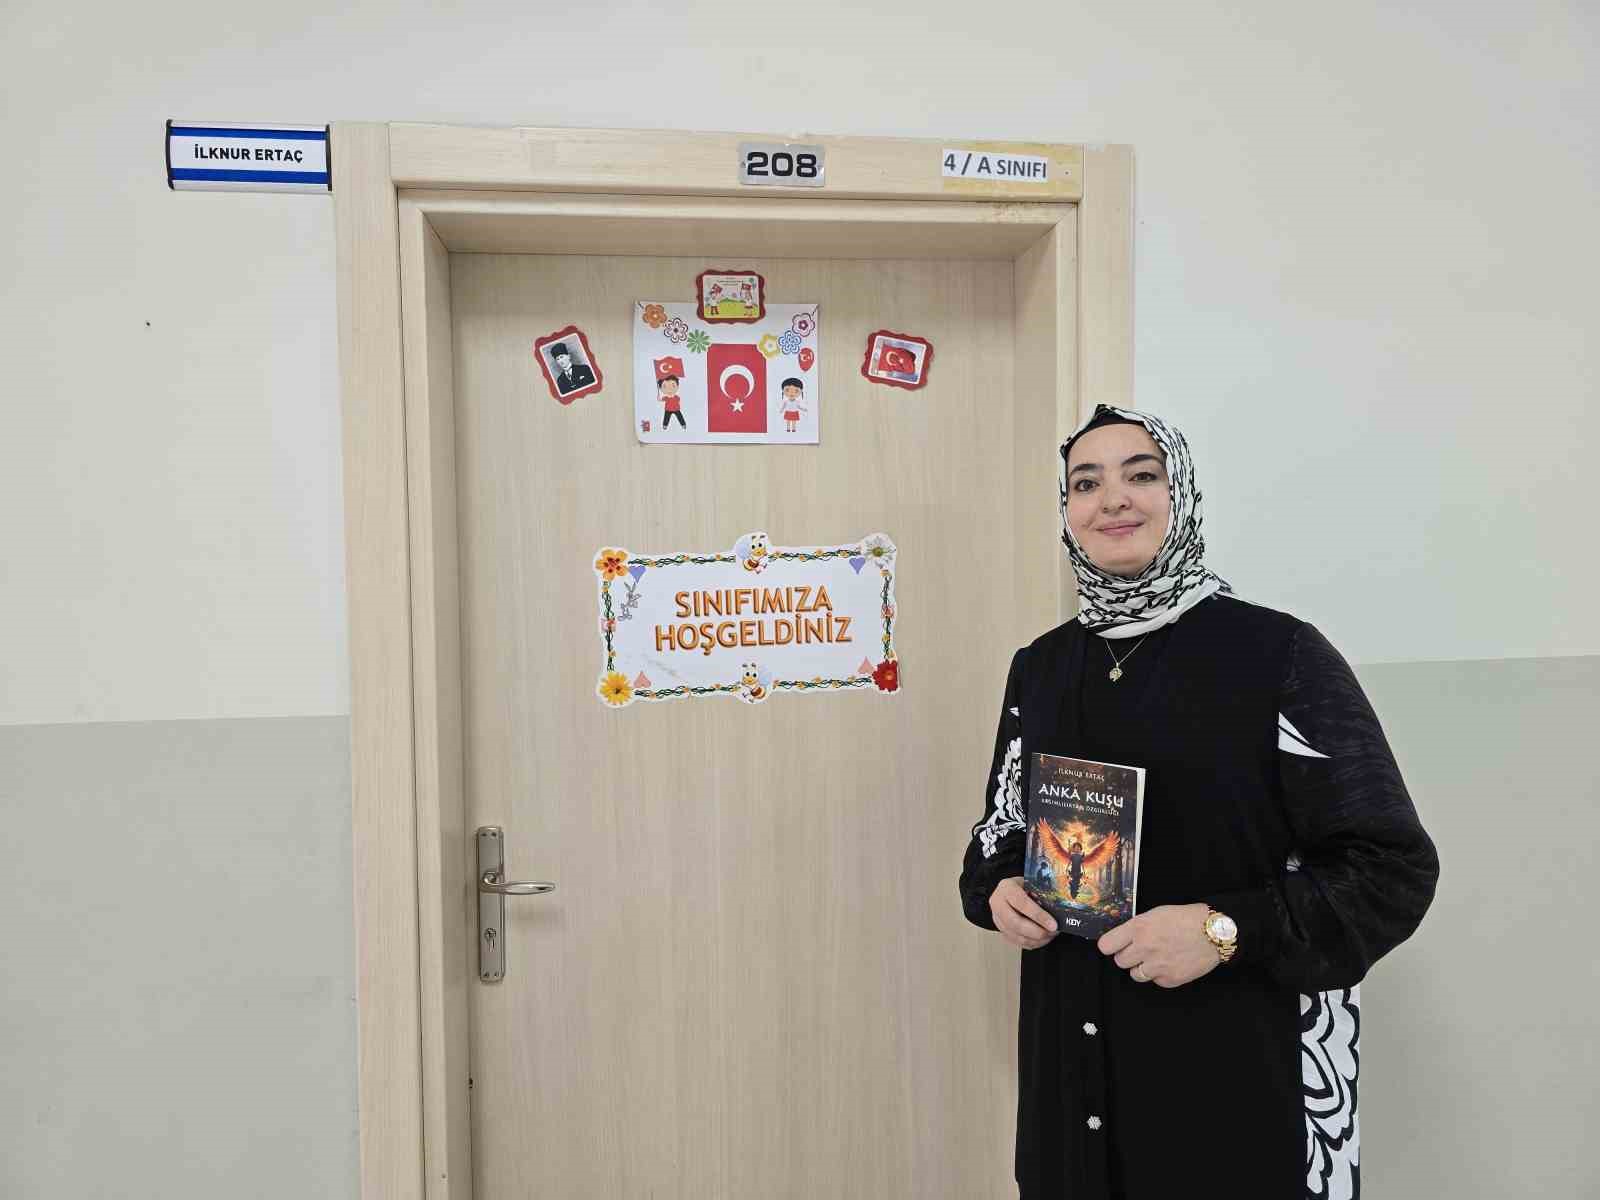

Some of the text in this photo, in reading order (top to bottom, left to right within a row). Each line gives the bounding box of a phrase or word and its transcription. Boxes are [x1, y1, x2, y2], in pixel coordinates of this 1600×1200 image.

[194, 144, 303, 163] İLKNUR ERTAÇ
[747, 152, 817, 177] 208
[944, 153, 1046, 178] 4 / A SINIFI
[675, 585, 833, 618] SINIFIMIZA
[655, 612, 852, 656] HOŞGELDİNİZ
[1086, 790, 1124, 809] KUŞU
